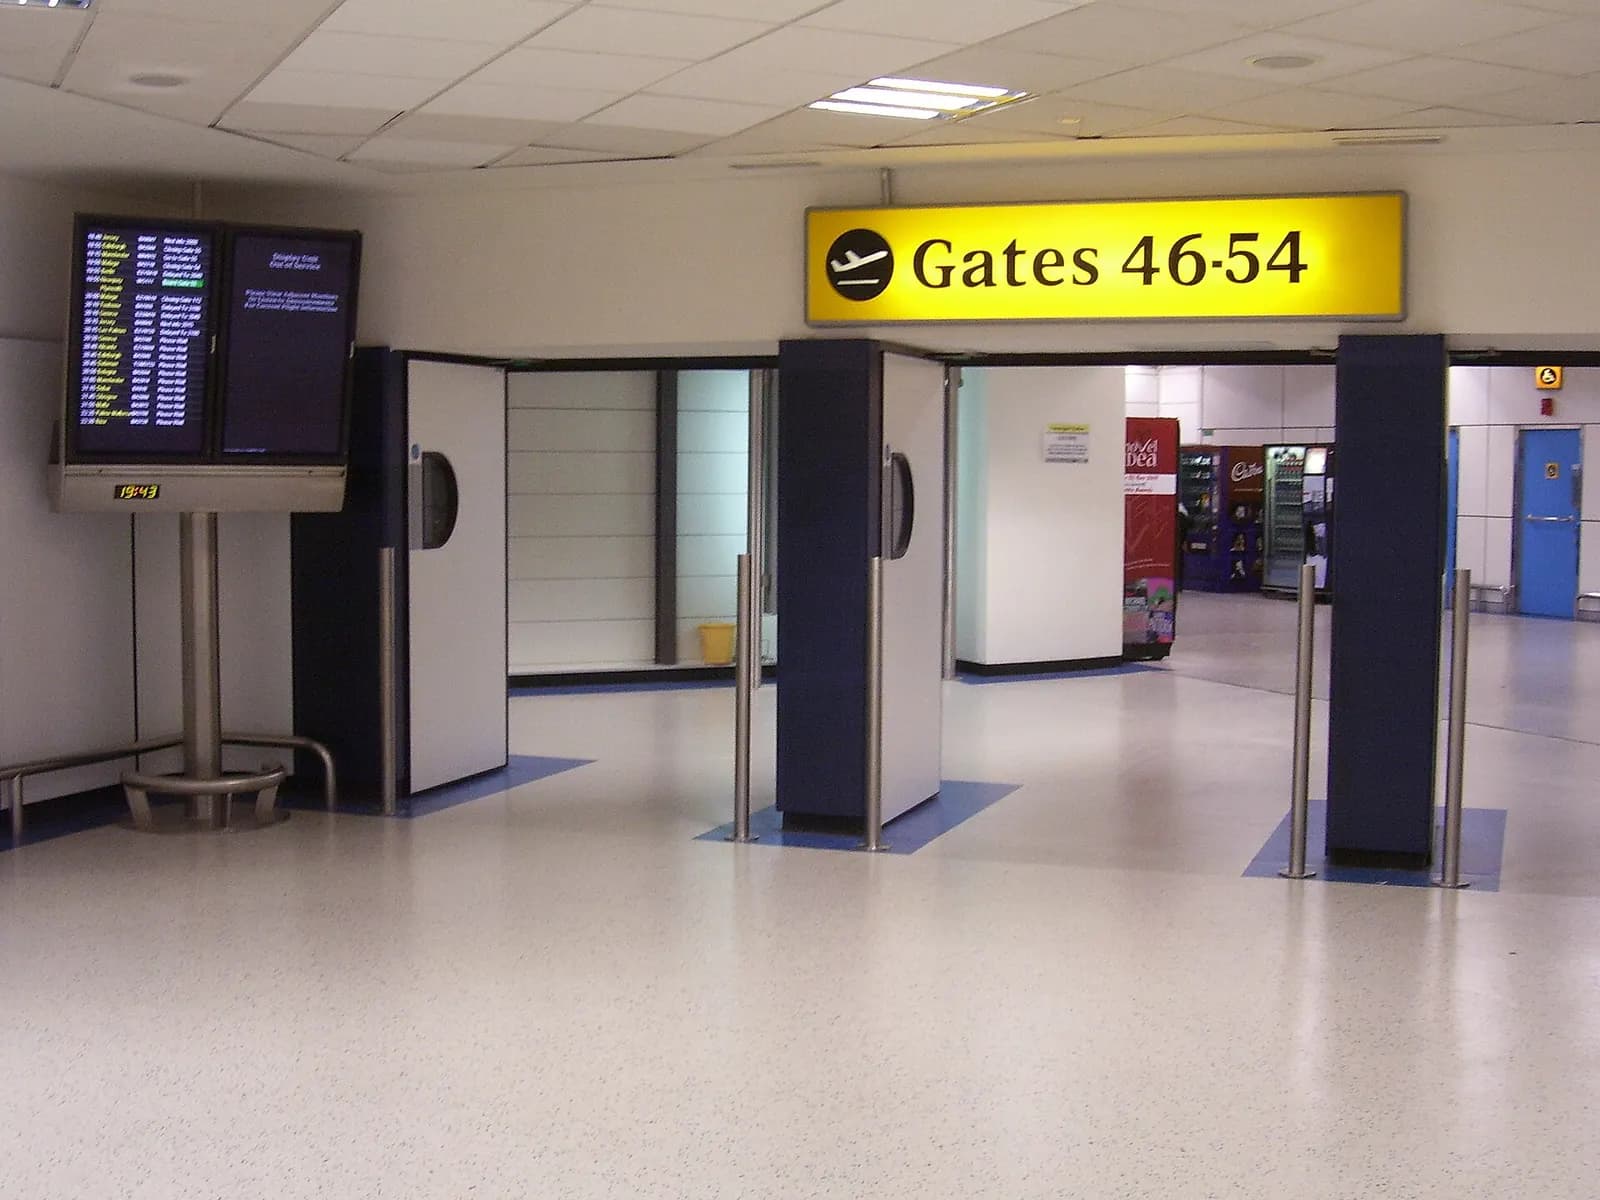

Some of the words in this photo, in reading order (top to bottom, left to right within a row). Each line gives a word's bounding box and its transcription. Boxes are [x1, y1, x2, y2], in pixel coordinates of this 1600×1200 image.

[913, 237, 1099, 289] Gates
[1121, 230, 1308, 286] 46-54
[120, 485, 158, 499] 19:43
